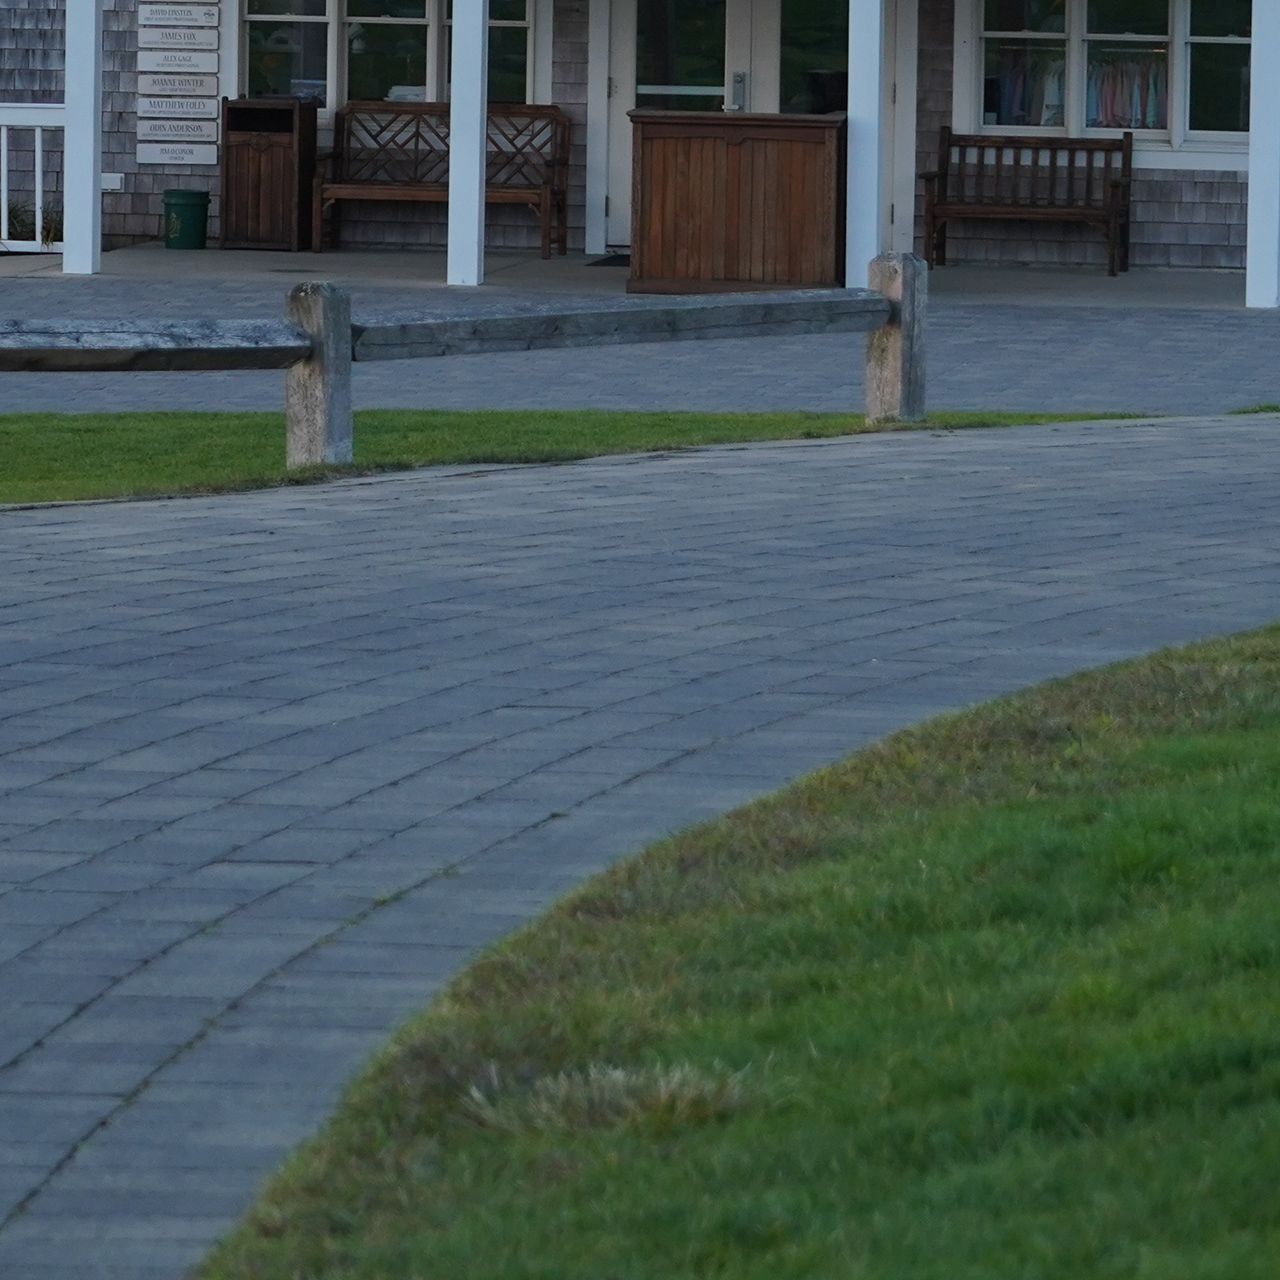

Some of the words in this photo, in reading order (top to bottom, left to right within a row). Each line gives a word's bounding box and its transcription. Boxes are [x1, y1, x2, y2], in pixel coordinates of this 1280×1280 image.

[160, 32, 182, 40] JAMES
[183, 32, 197, 41] FOX
[151, 78, 177, 86] JOANNE
[178, 78, 205, 87] WINTER
[149, 100, 185, 109] MATTHEW
[185, 101, 207, 110] FOLEY
[149, 124, 167, 132] ODIN
[167, 124, 203, 132] ANDERSON
